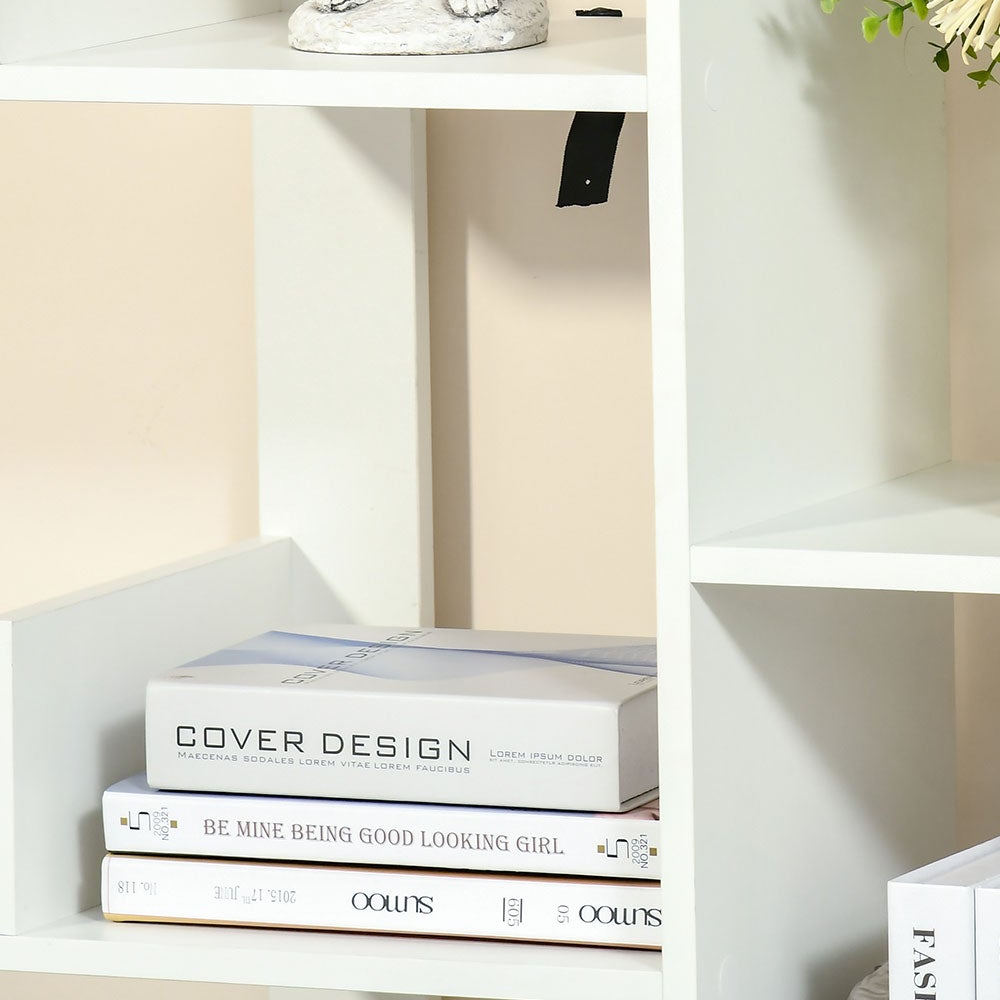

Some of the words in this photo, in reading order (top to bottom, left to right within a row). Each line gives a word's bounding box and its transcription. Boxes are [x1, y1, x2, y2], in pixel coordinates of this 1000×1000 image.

[176, 725, 304, 753] COVER
[322, 732, 471, 762] DESIGN
[489, 749, 526, 758] LOREM
[530, 752, 563, 761] IPSUM
[567, 754, 603, 763] DOLOR
[243, 755, 294, 765] SODALES
[299, 759, 336, 767] LOREM
[341, 760, 371, 769] VITAE
[374, 763, 411, 771] LOREM
[416, 764, 471, 774] FAUCIBUS
[203, 818, 230, 836] BE
[236, 820, 285, 839] MINE
[291, 824, 352, 843] BEING
[359, 827, 414, 847] GOOD
[421, 830, 509, 851] LOOKING
[516, 835, 565, 855] GIRL
[631, 838, 640, 864] 2009
[639, 834, 649, 869] NO.321
